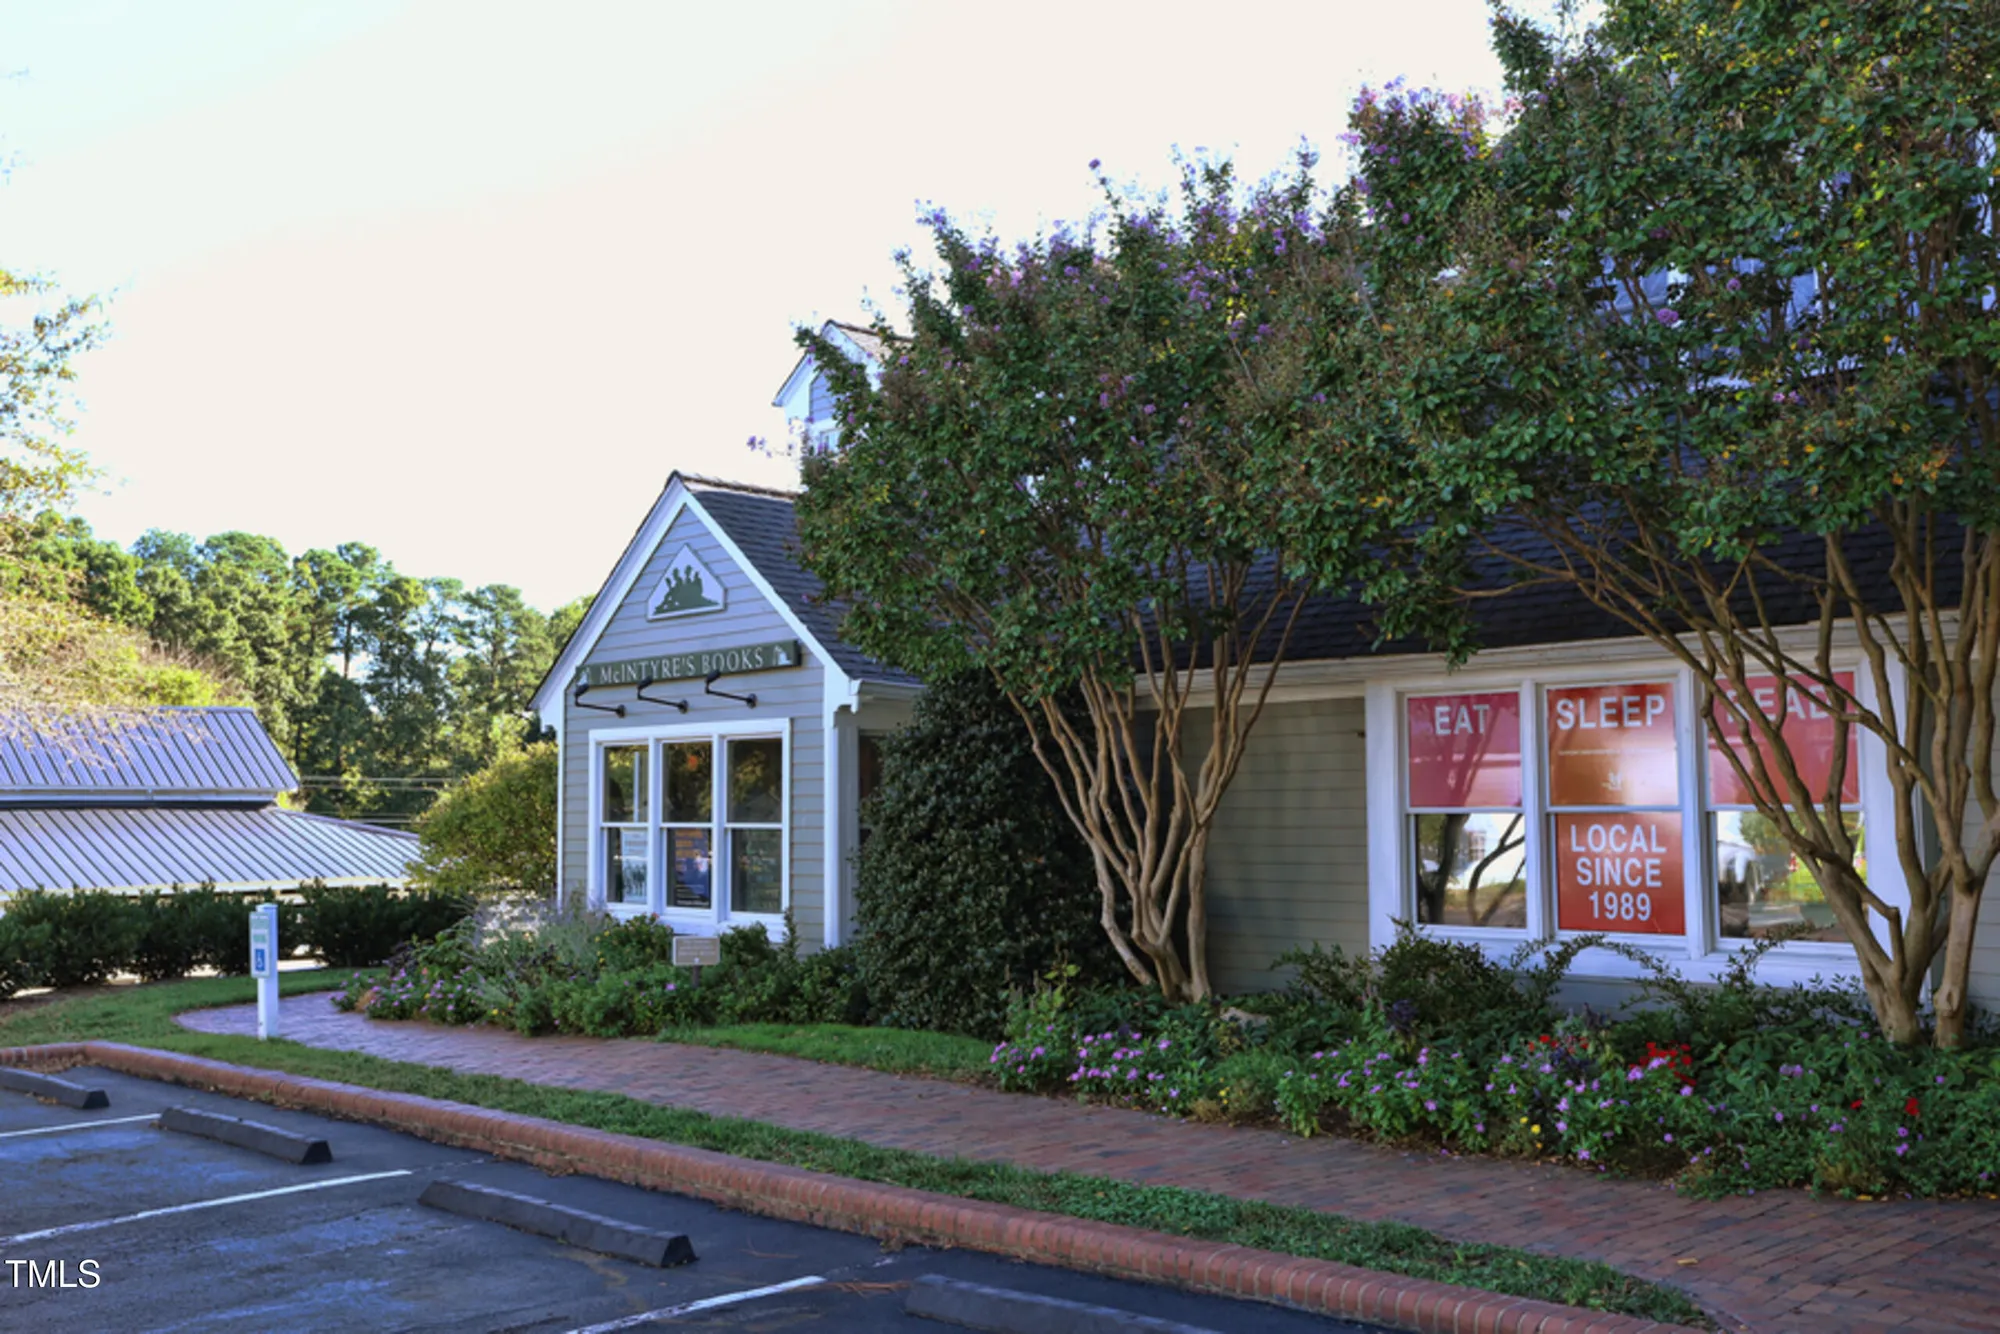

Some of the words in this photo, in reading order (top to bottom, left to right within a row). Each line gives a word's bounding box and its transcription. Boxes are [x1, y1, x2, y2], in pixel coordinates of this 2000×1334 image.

[600, 655, 696, 684] McINTYRE'S
[702, 646, 764, 674] BOOKS
[1434, 703, 1490, 735] EAT
[1556, 694, 1666, 730] SLEEP
[1571, 823, 1667, 853] LOCAL
[1576, 856, 1662, 888] SINCE
[1588, 891, 1652, 921] 1989
